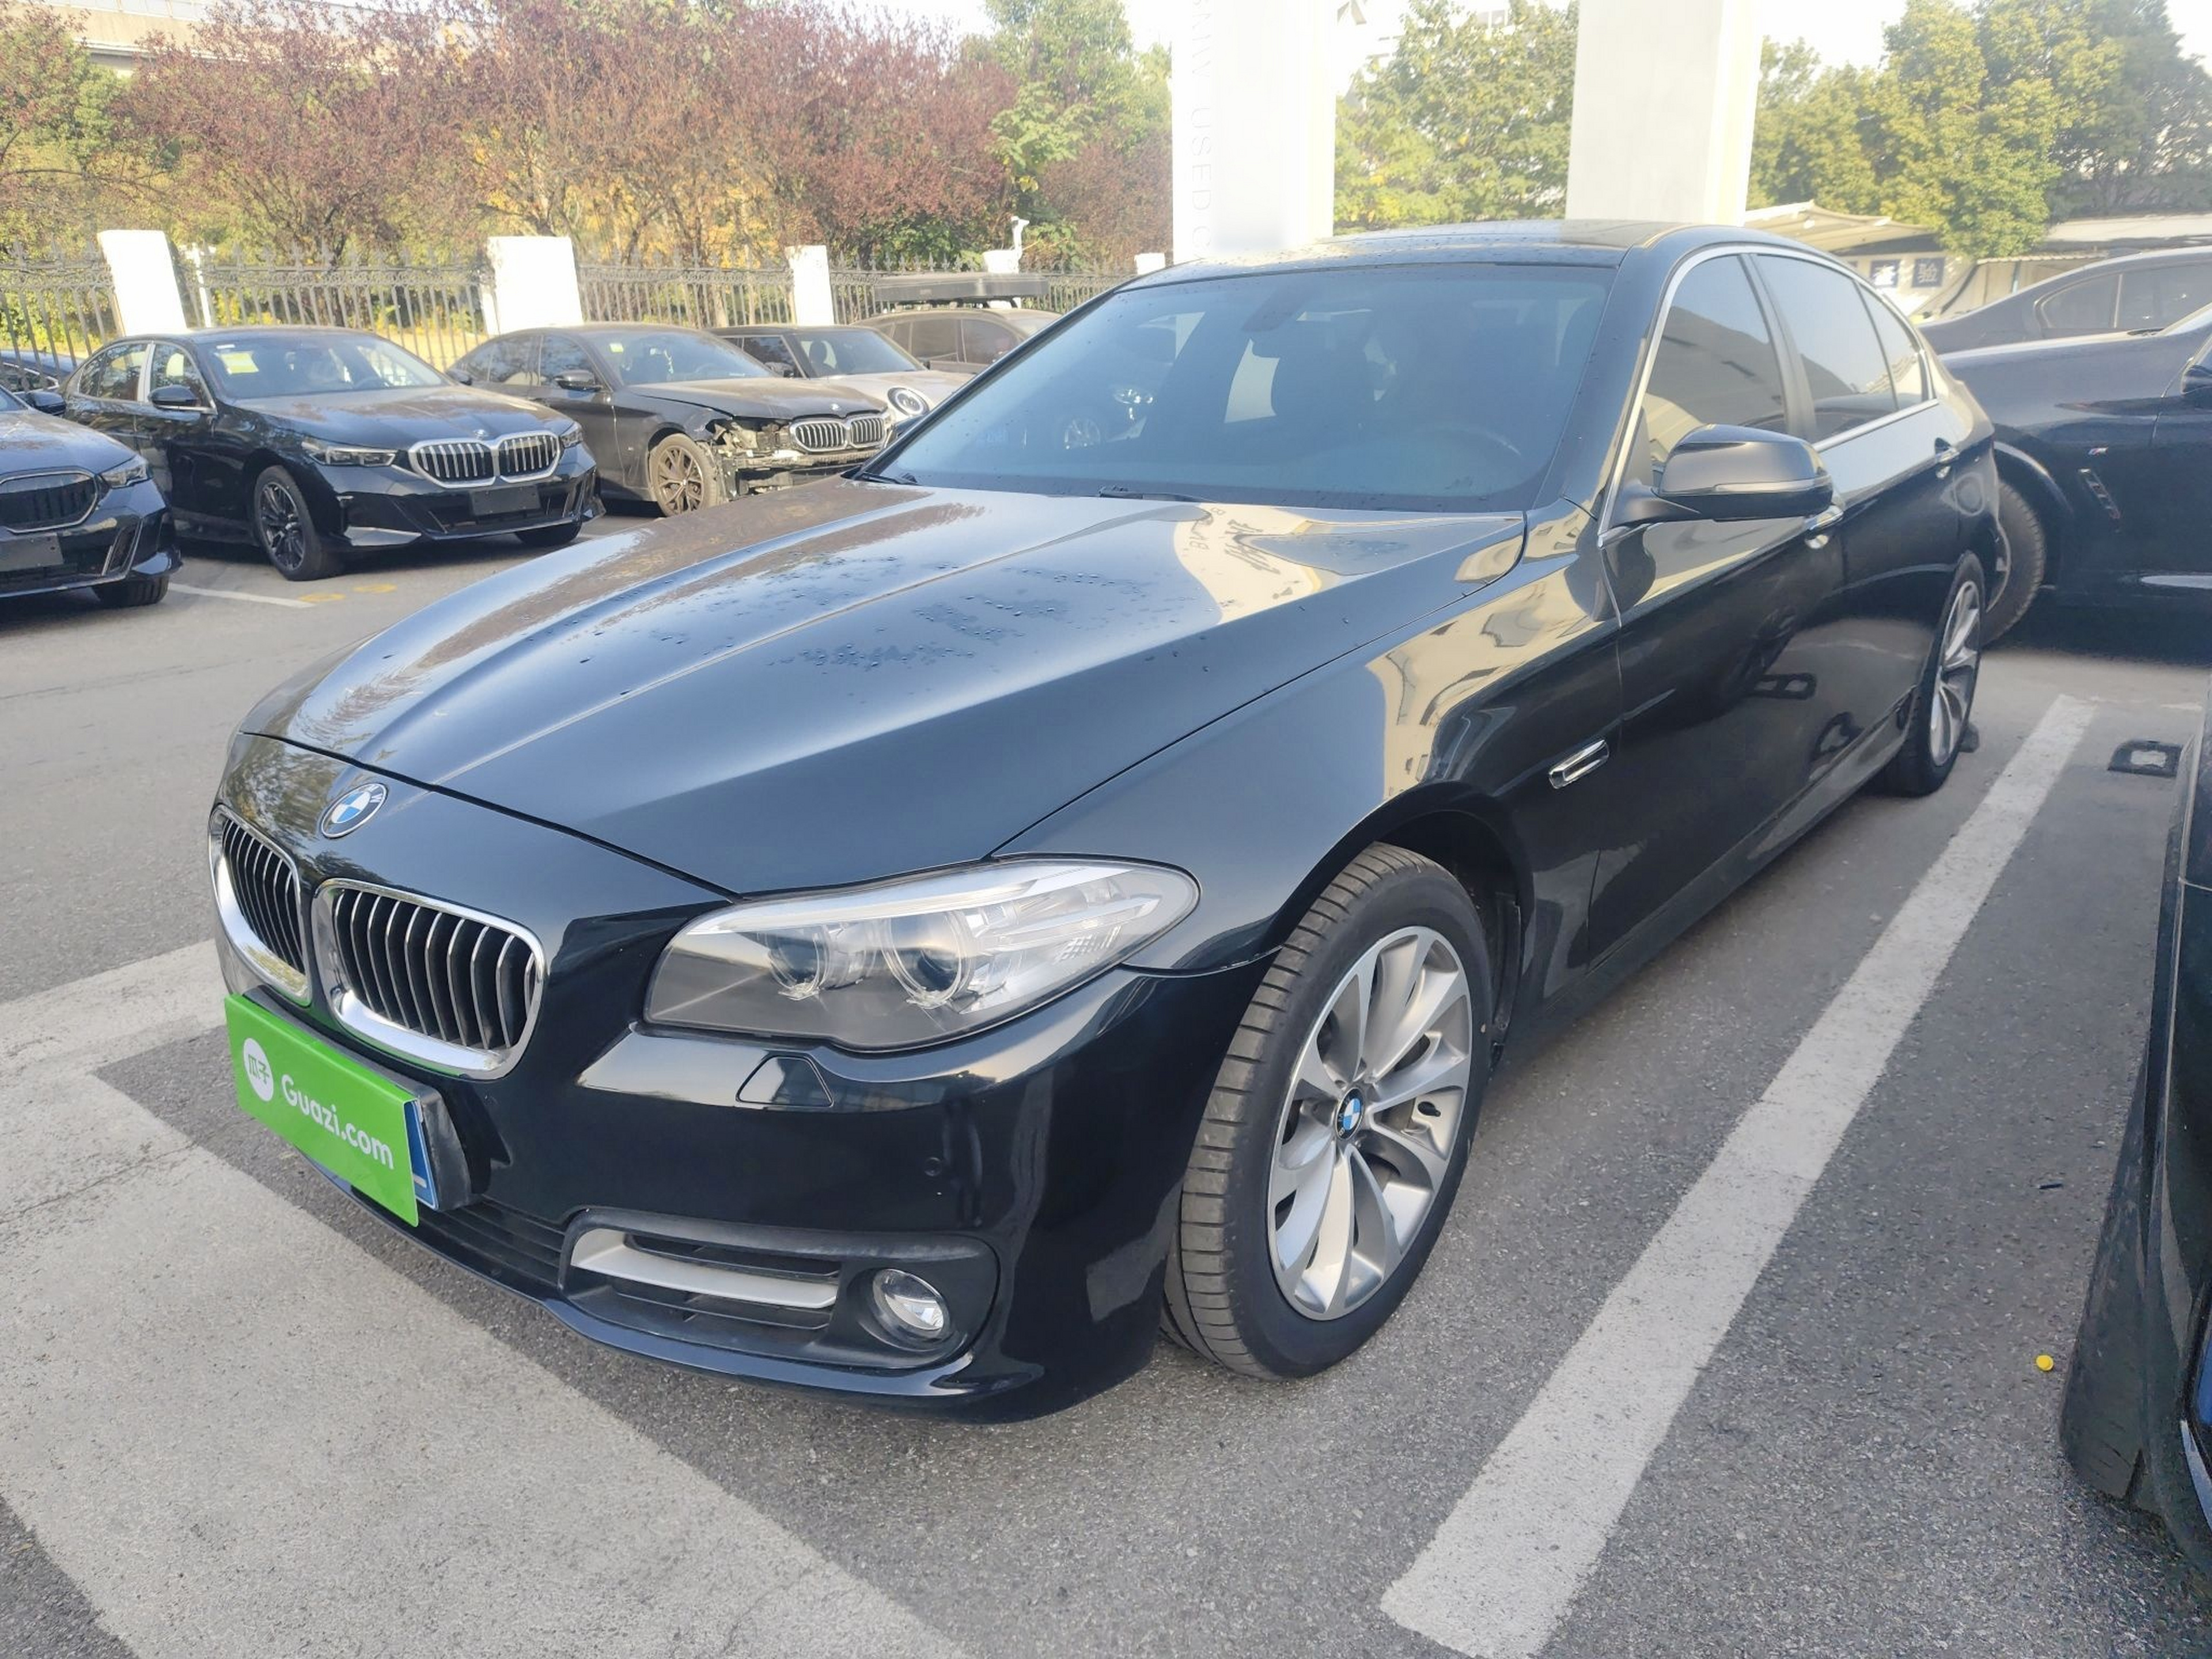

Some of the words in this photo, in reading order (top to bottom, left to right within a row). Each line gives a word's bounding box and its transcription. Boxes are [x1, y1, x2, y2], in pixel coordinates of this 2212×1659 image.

[1191, 107, 1212, 210] USED
[248, 1054, 270, 1085] 瓜子
[281, 1074, 394, 1170] Guazi.com
